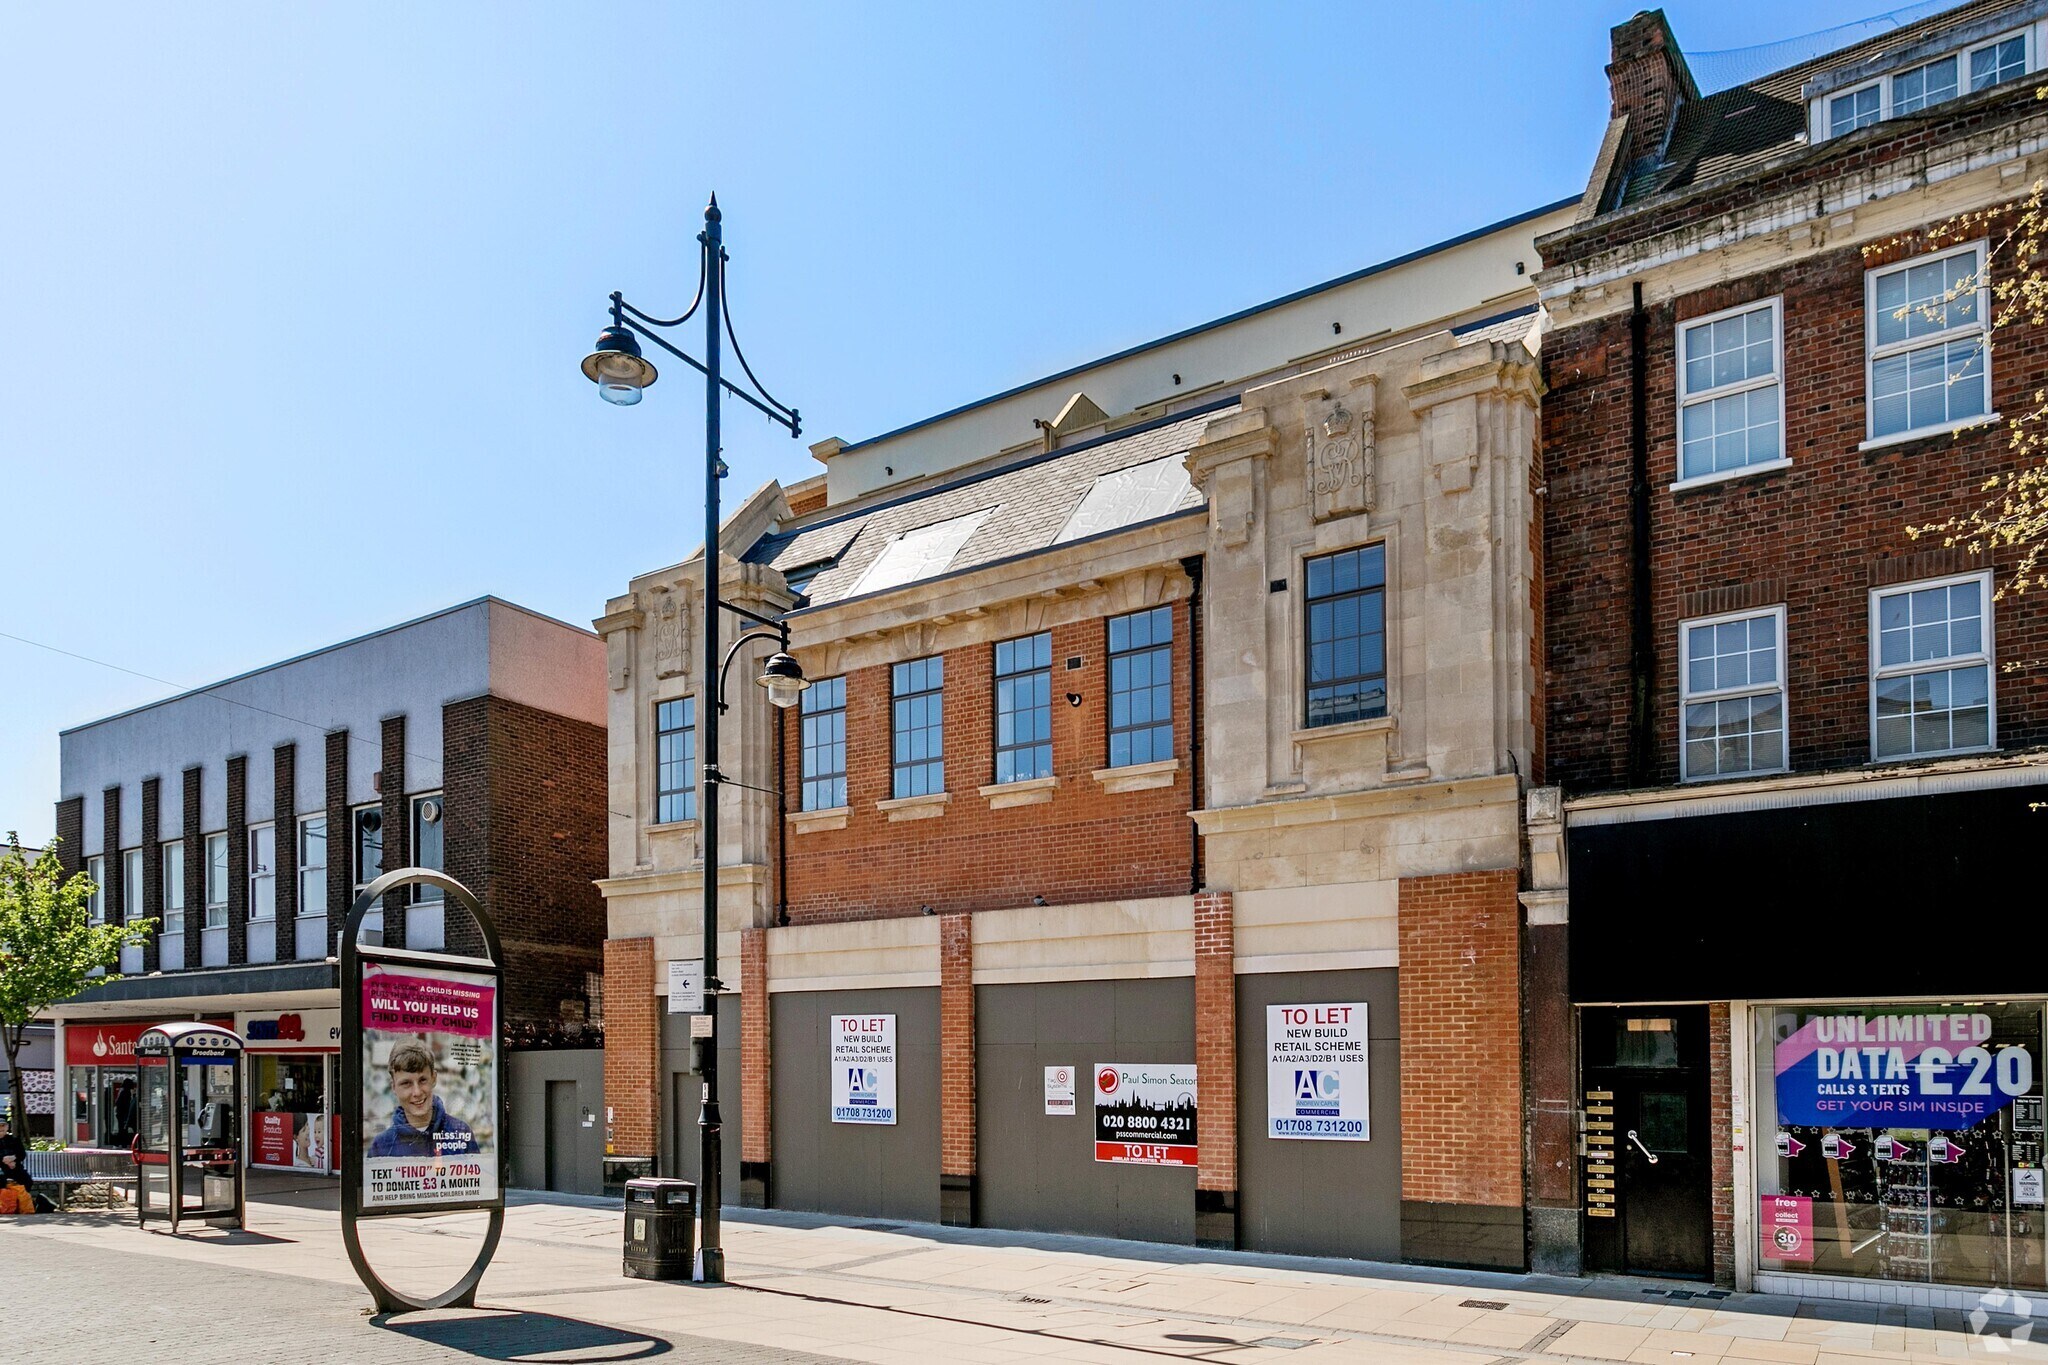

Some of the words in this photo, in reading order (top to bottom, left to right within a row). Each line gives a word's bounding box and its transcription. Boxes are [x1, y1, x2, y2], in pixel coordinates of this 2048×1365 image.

[371, 990, 388, 998] PUTS
[412, 993, 440, 1002] CLOSER
[426, 986, 444, 994] CHILD
[452, 988, 480, 998] MISSING
[371, 998, 400, 1011] WILL
[403, 1000, 428, 1013] YOU
[431, 1003, 461, 1016] HELP
[463, 1008, 479, 1019] US
[371, 1012, 399, 1023] FIND
[402, 1014, 437, 1025] EVERY
[442, 1017, 478, 1029] CHILD?
[1282, 1009, 1308, 1025] TO
[1315, 1008, 1352, 1024] LET
[840, 1019, 858, 1032] TO
[862, 1018, 885, 1032] LET
[1816, 1013, 1992, 1042] UNLIMITED
[1287, 1029, 1311, 1038] NEW
[1315, 1028, 1348, 1037] BUILD
[192, 1048, 225, 1056] Broadband
[1275, 1042, 1311, 1051] RETAIL
[1315, 1042, 1361, 1051] SCHEME
[1818, 1047, 1908, 1080] DATA
[1915, 1046, 2033, 1097] £20
[849, 1068, 877, 1091] AC
[1122, 1073, 1139, 1084] Paul
[1142, 1073, 1167, 1084] Simon
[1295, 1070, 1339, 1099] AC
[1818, 1083, 1855, 1095] CALLS
[1858, 1084, 1868, 1095] &
[1871, 1084, 1910, 1096] TEXTS
[836, 1107, 860, 1117] 01708
[862, 1108, 891, 1118] 731200
[1816, 1100, 1846, 1111] GET
[1851, 1100, 1893, 1112] YOUR
[1898, 1101, 1925, 1112] SIM
[1931, 1101, 1984, 1113] INSIDE
[264, 1116, 280, 1125] Quality
[1103, 1115, 1124, 1128] 020
[1128, 1116, 1157, 1129] 8800
[1160, 1118, 1190, 1130] 4321
[1276, 1120, 1312, 1131] 01708
[1316, 1121, 1362, 1132] 731200
[263, 1126, 282, 1134] Products
[432, 1130, 472, 1142] missing
[1116, 1131, 1177, 1139] psscommercial.com
[436, 1141, 467, 1151] people
[1124, 1145, 1142, 1157] TO
[1147, 1146, 1169, 1159] LET
[371, 1168, 393, 1179] TEXT
[435, 1167, 446, 1177] TO
[372, 1182, 383, 1192] TO
[386, 1180, 420, 1192] DONATE
[423, 1177, 437, 1190] £3
[440, 1180, 447, 1189] A
[449, 1178, 480, 1188] MONTH
[1775, 1198, 1797, 1207] free
[1778, 1233, 1796, 1244] 30
